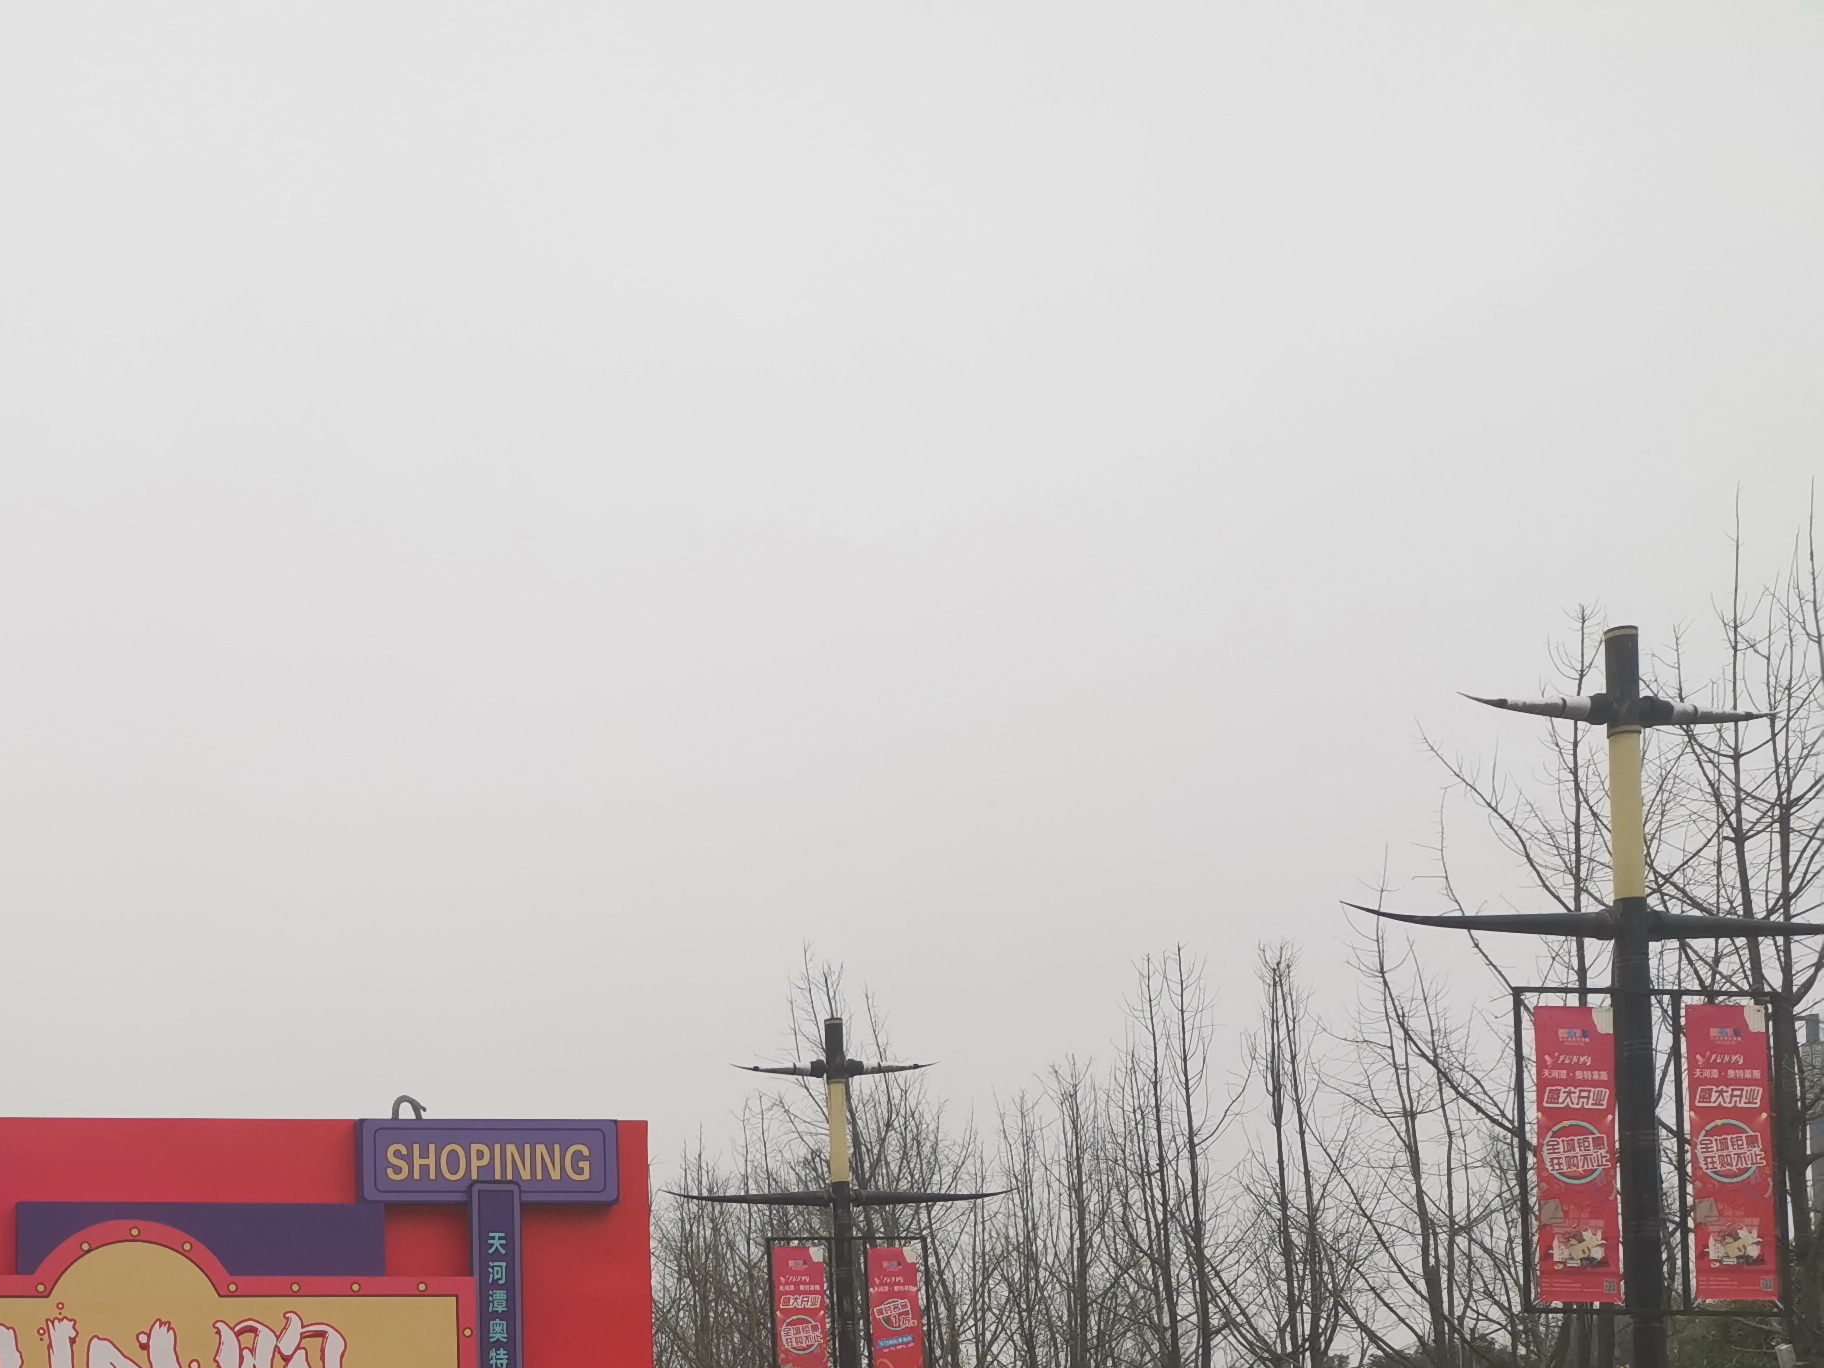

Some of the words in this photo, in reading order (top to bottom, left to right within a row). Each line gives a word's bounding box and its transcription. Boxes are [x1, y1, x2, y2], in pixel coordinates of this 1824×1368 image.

[1543, 1086, 1610, 1109] 盛大开业
[1695, 1085, 1763, 1107] 盛大开业
[385, 1142, 591, 1181] SHOPINNG
